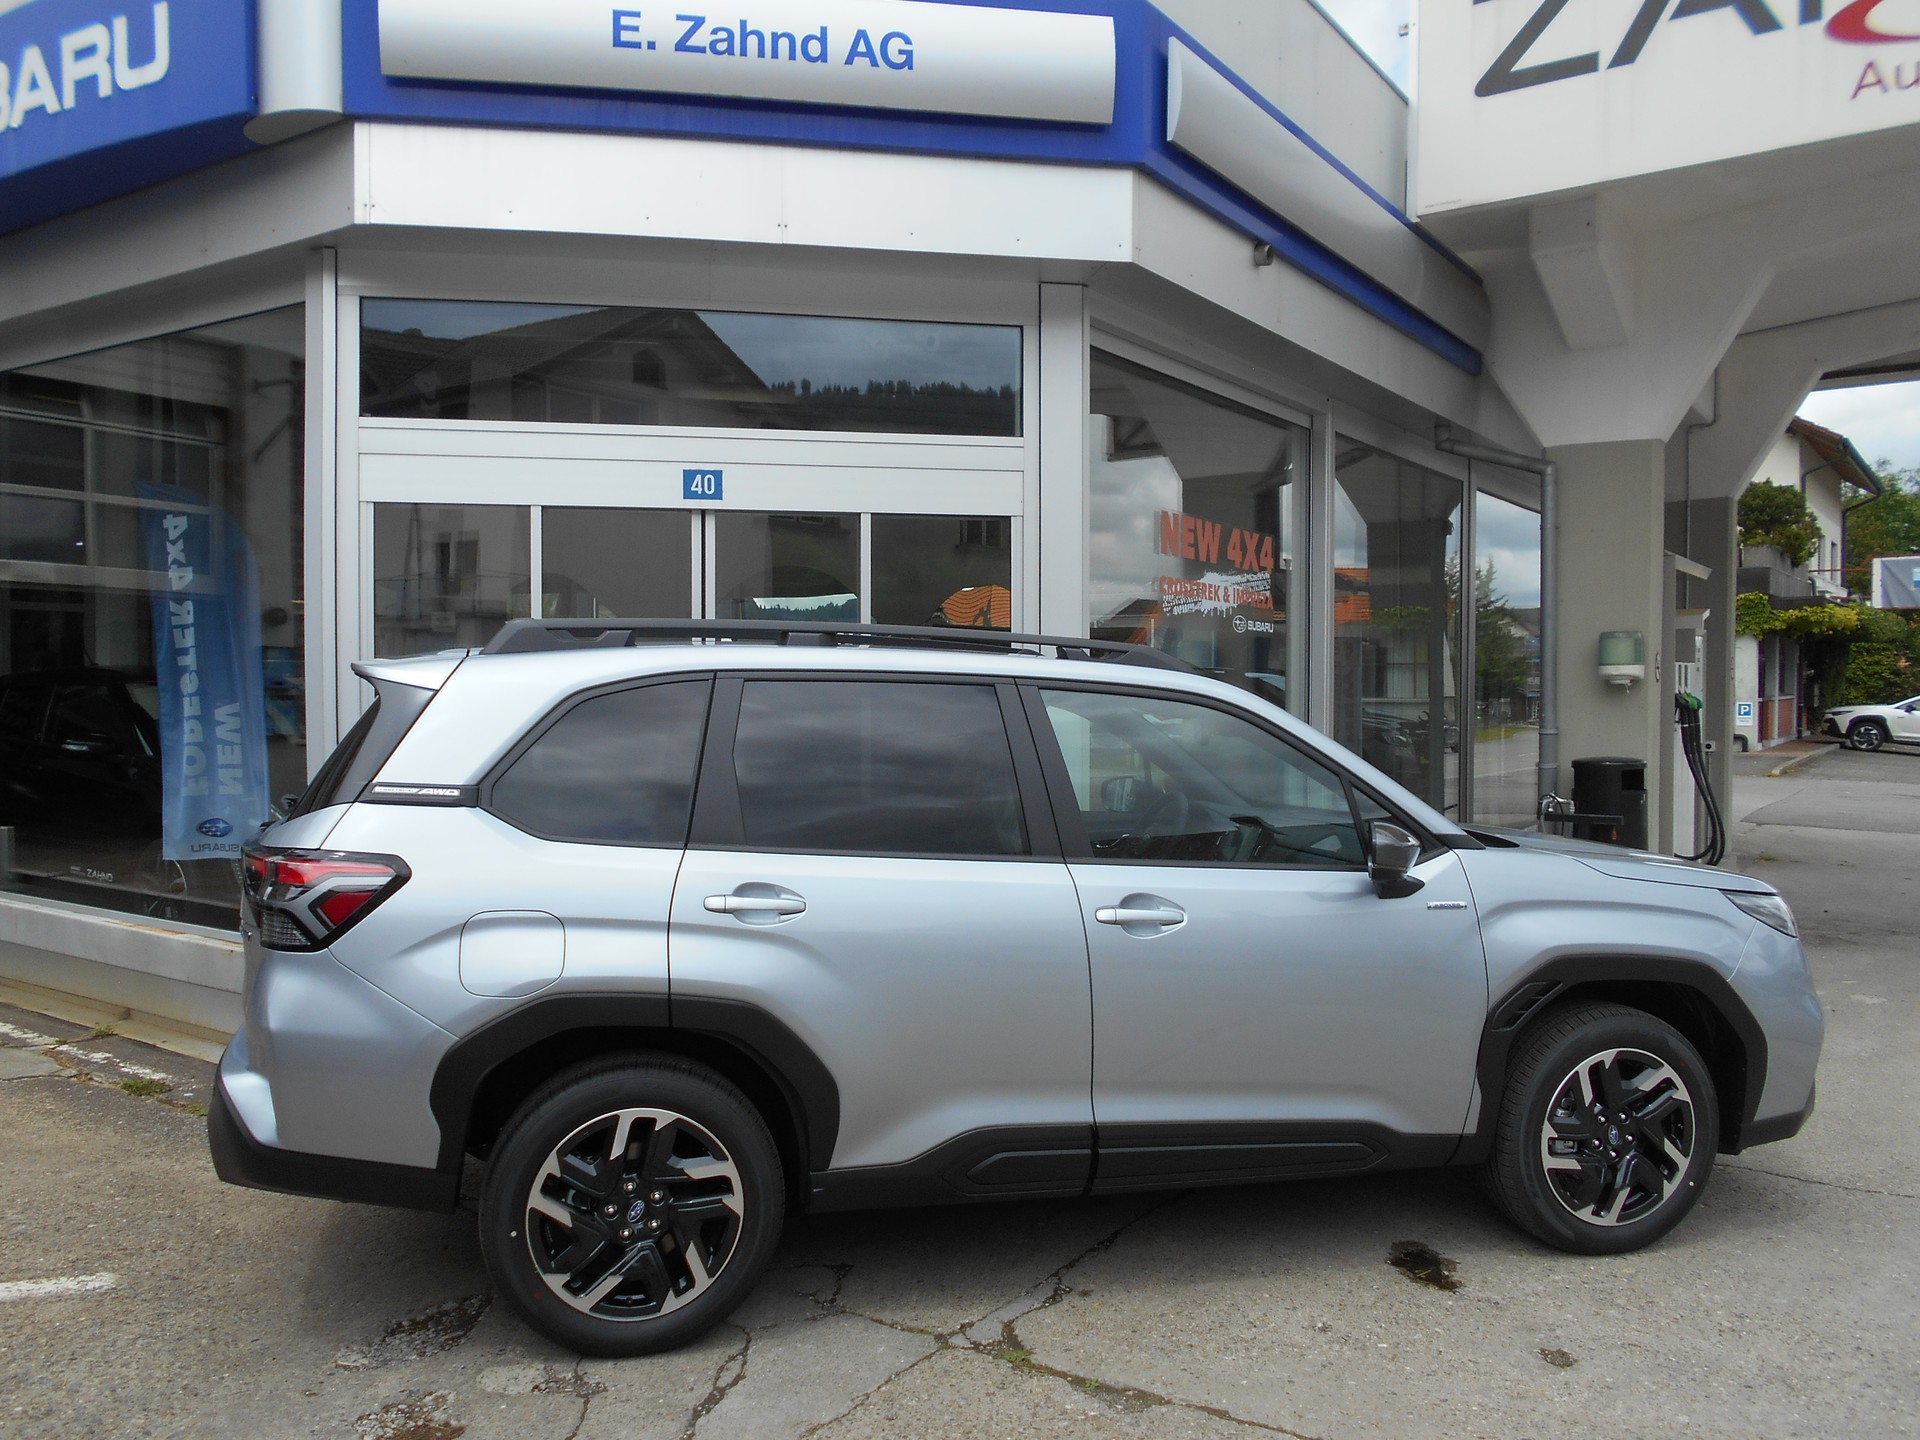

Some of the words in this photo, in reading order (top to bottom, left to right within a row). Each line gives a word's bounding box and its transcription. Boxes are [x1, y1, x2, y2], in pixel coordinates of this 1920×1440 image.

[612, 9, 656, 50] E.
[674, 13, 829, 63] Zahnd
[844, 28, 914, 70] AG
[0, 1, 169, 132] ARU
[690, 474, 715, 495] 40
[1160, 510, 1222, 564] NEW
[1227, 527, 1275, 574] 4X4
[1223, 588, 1231, 603] &
[1233, 585, 1274, 610] IMPREZA
[1247, 620, 1274, 633] SUBARU
